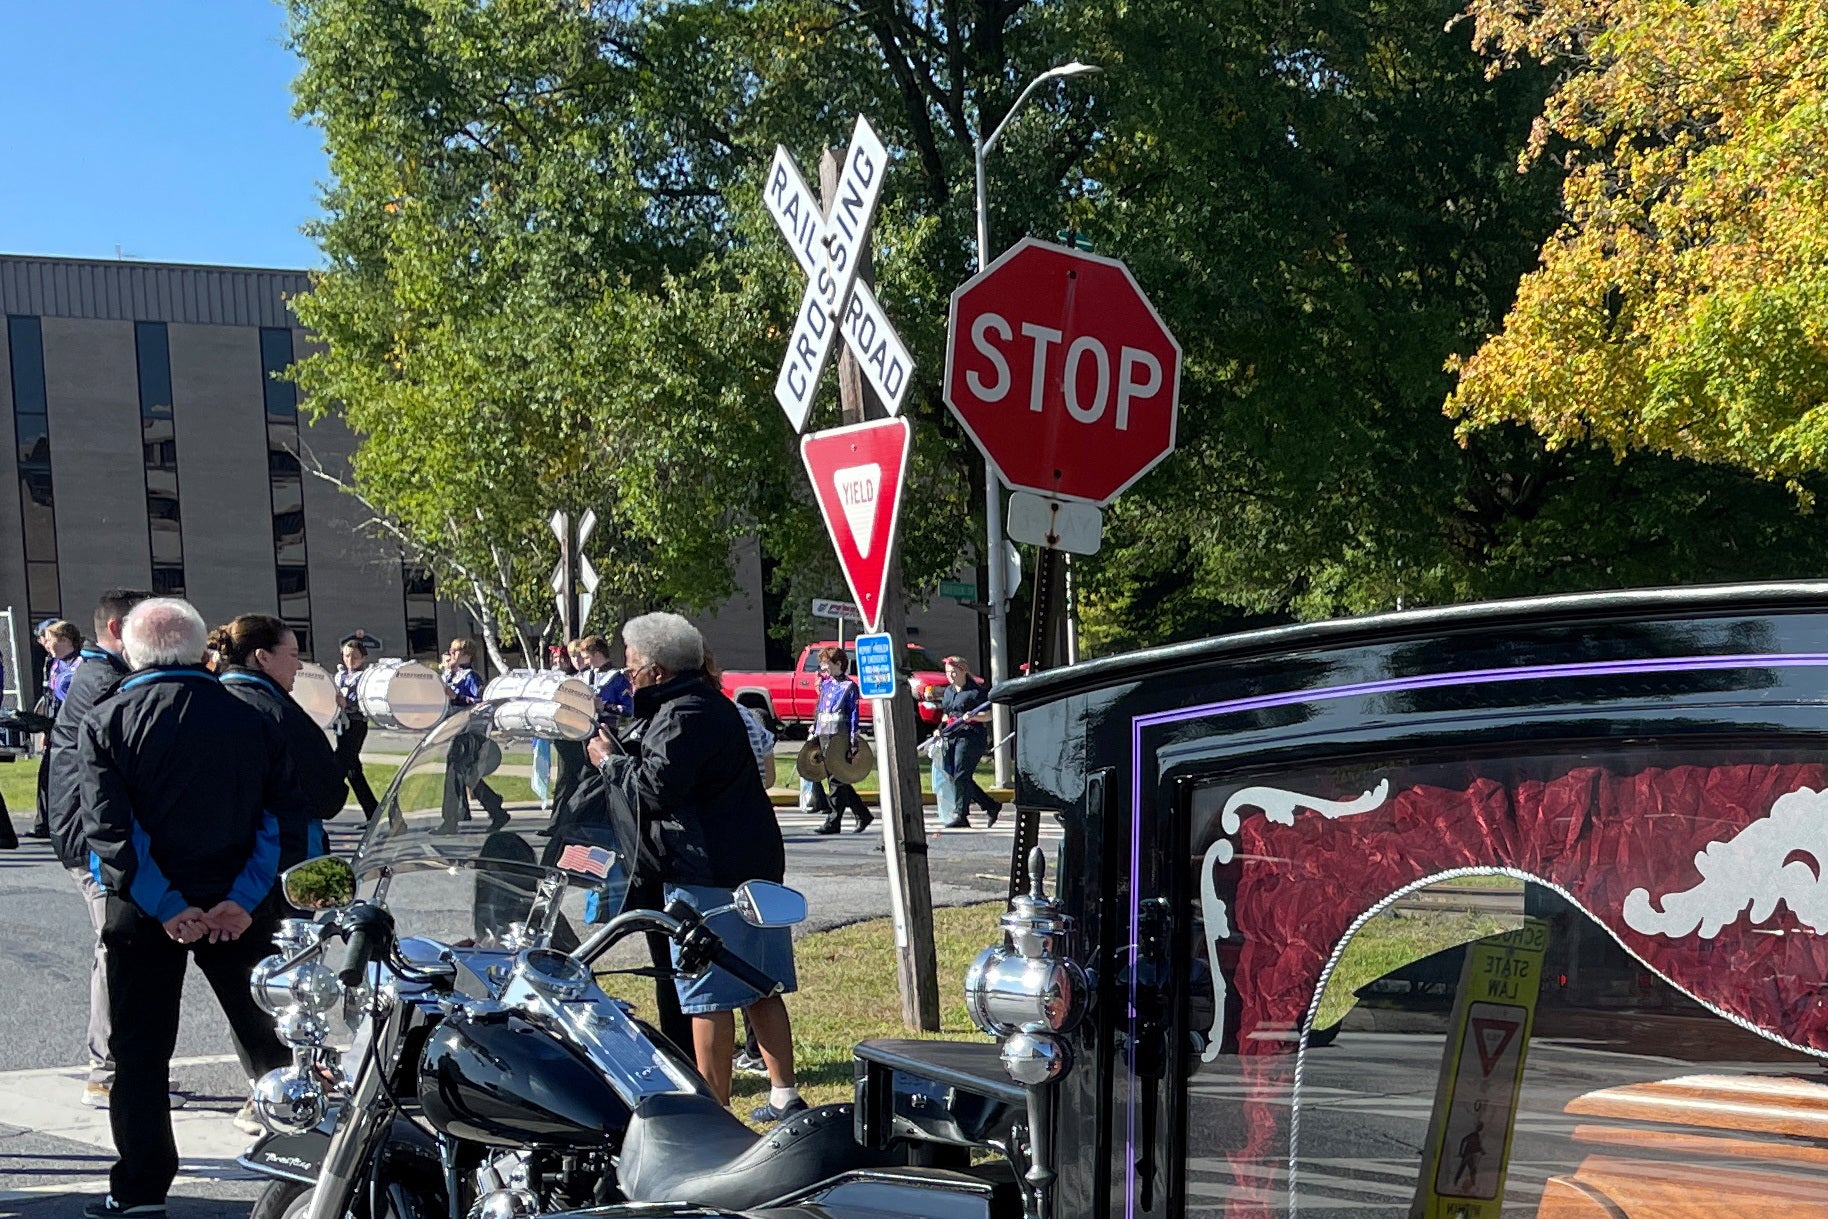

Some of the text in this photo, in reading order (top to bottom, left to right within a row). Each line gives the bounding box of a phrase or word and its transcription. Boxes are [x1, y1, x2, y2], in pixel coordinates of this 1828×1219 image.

[771, 161, 904, 400] RAIL ROAD
[787, 146, 874, 402] CROSSING
[966, 312, 1163, 431] STOP
[842, 479, 874, 505] YIELD
